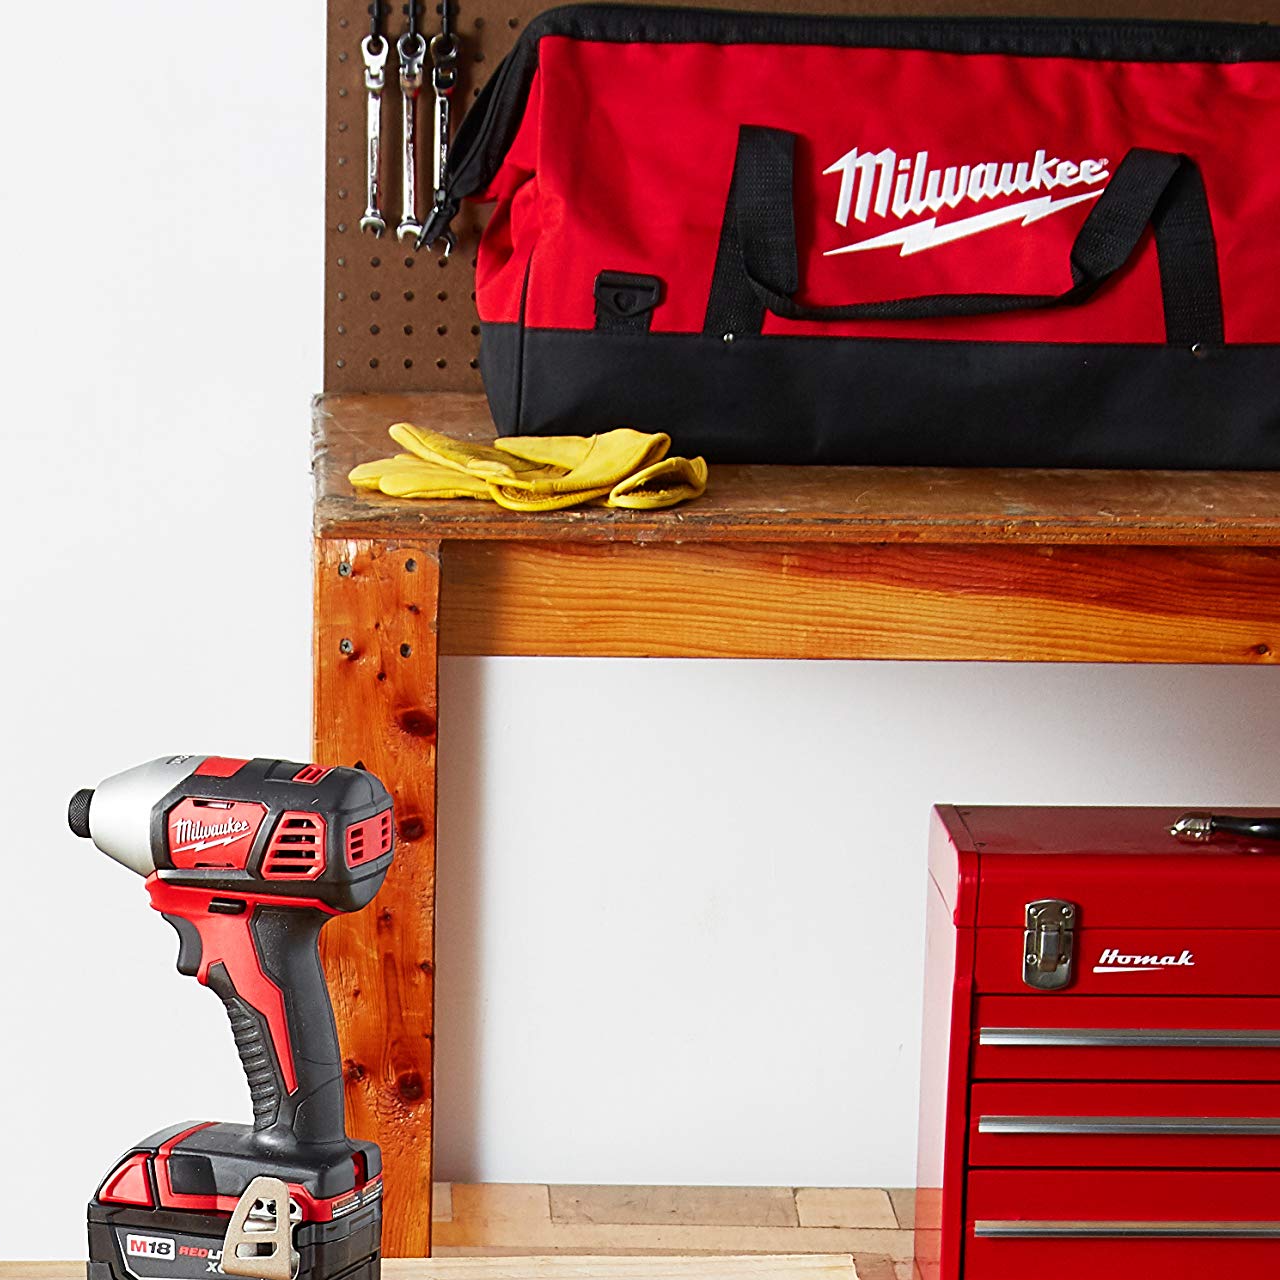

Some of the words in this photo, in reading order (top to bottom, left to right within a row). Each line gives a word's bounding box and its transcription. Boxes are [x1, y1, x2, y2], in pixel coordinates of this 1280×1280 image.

[822, 146, 1109, 227] Milwaukee
[171, 816, 250, 845] Milwaukee
[1098, 948, 1195, 966] Homak
[130, 1239, 171, 1256] M18
